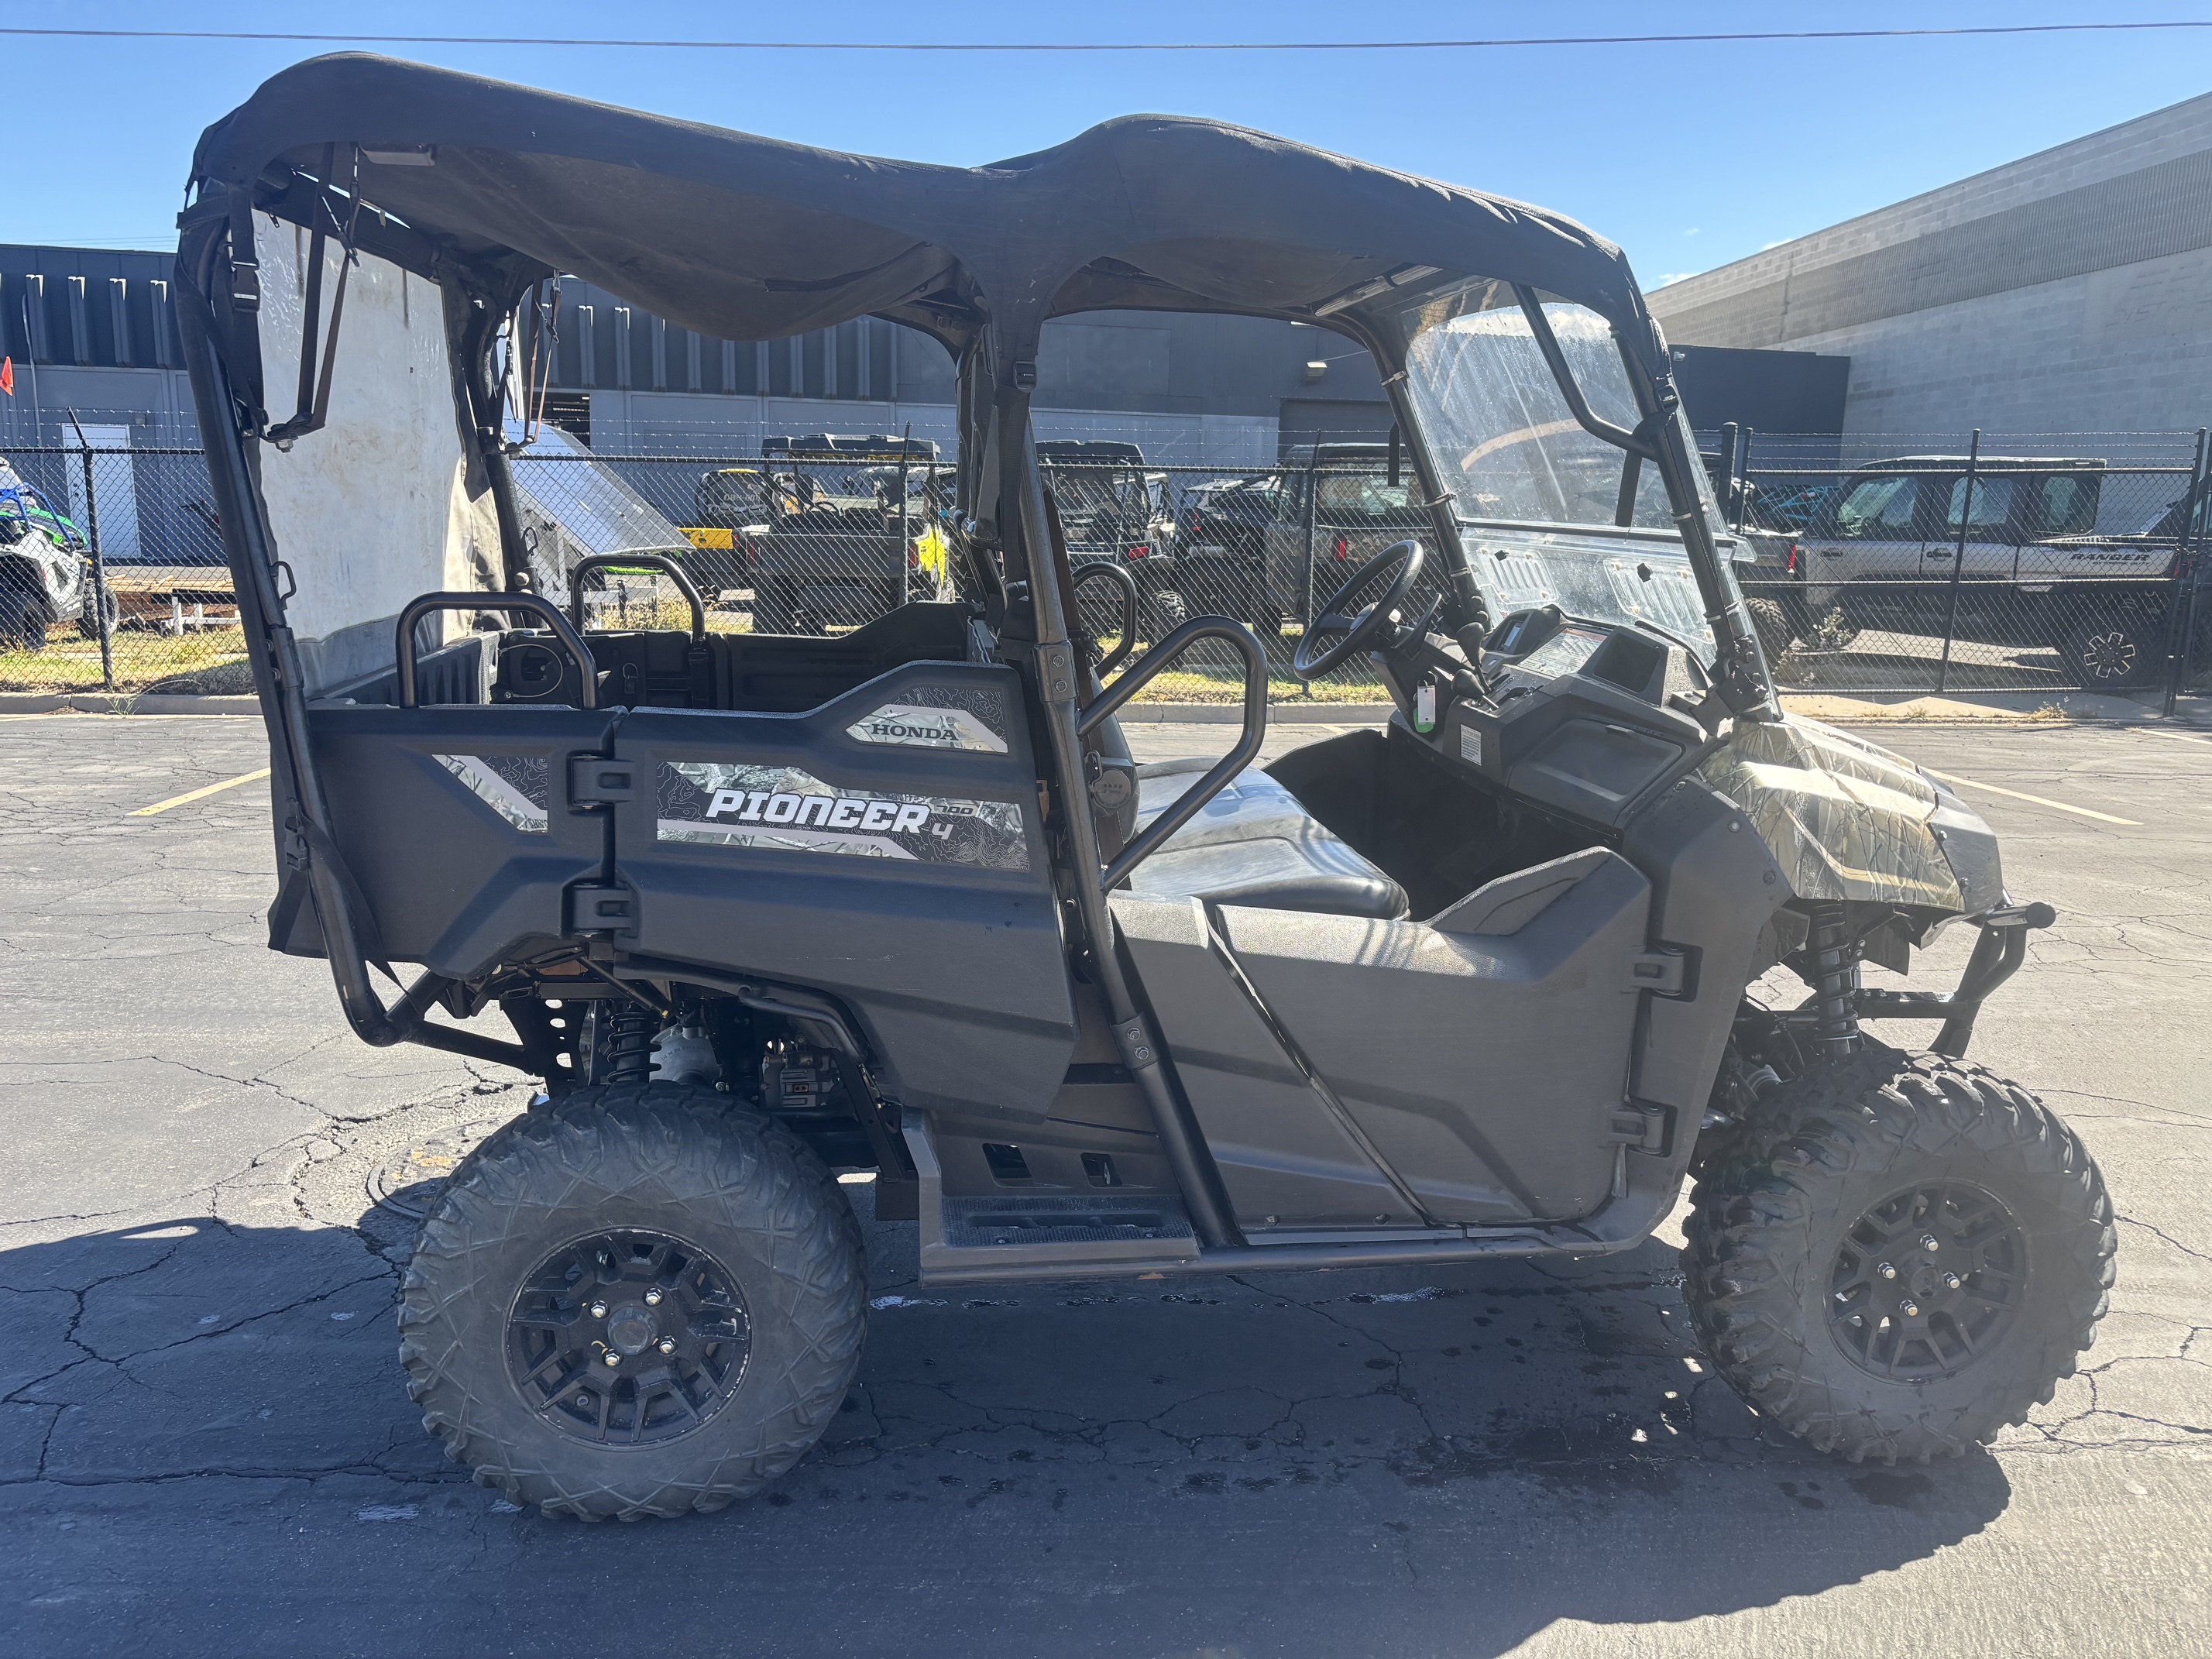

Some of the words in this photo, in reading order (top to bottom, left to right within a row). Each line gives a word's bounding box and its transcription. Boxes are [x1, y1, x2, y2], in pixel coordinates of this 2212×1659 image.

[2069, 553, 2151, 562] RANGER
[871, 723, 960, 741] HONDA
[706, 788, 931, 834] PIONEER
[936, 805, 974, 815] 700
[931, 823, 954, 840] 4
